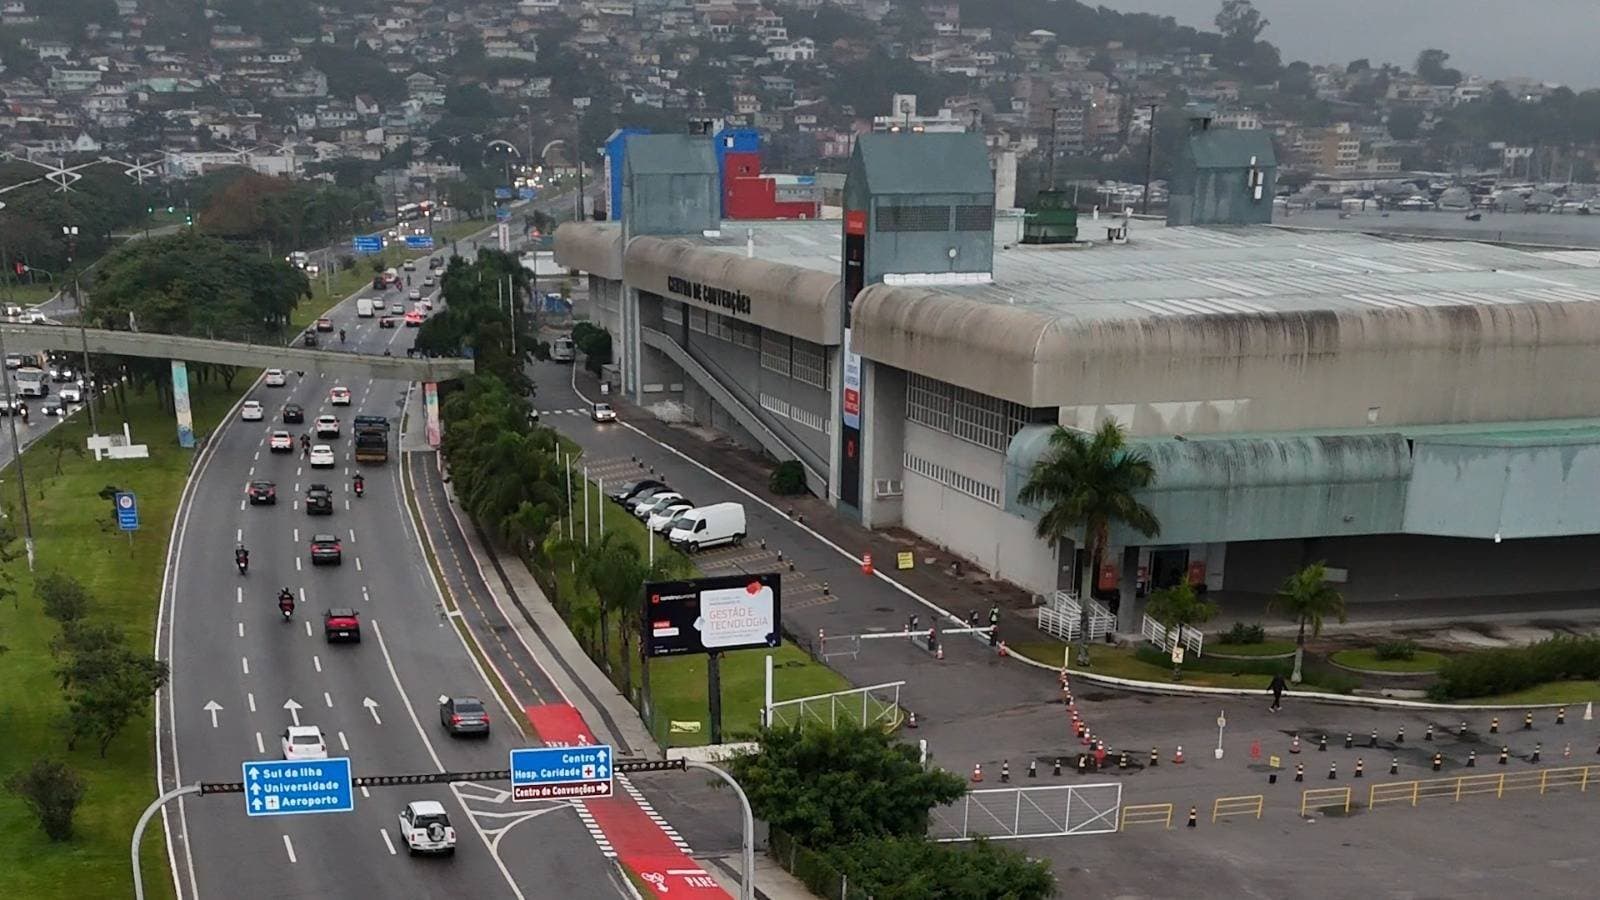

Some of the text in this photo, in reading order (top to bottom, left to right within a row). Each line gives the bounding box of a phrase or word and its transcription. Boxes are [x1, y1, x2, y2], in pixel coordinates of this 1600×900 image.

[709, 606, 754, 619] GESTÃO E
[710, 617, 768, 631] TECNOLOGIA
[562, 754, 595, 763] Centro
[263, 767, 322, 779] Sul da Ilha
[515, 767, 580, 780] Hosp. Caridade
[264, 781, 339, 793] Universidade
[515, 784, 595, 797] Centro de Convenções
[282, 796, 338, 807] Aeroporto
[684, 876, 718, 887] PARE
